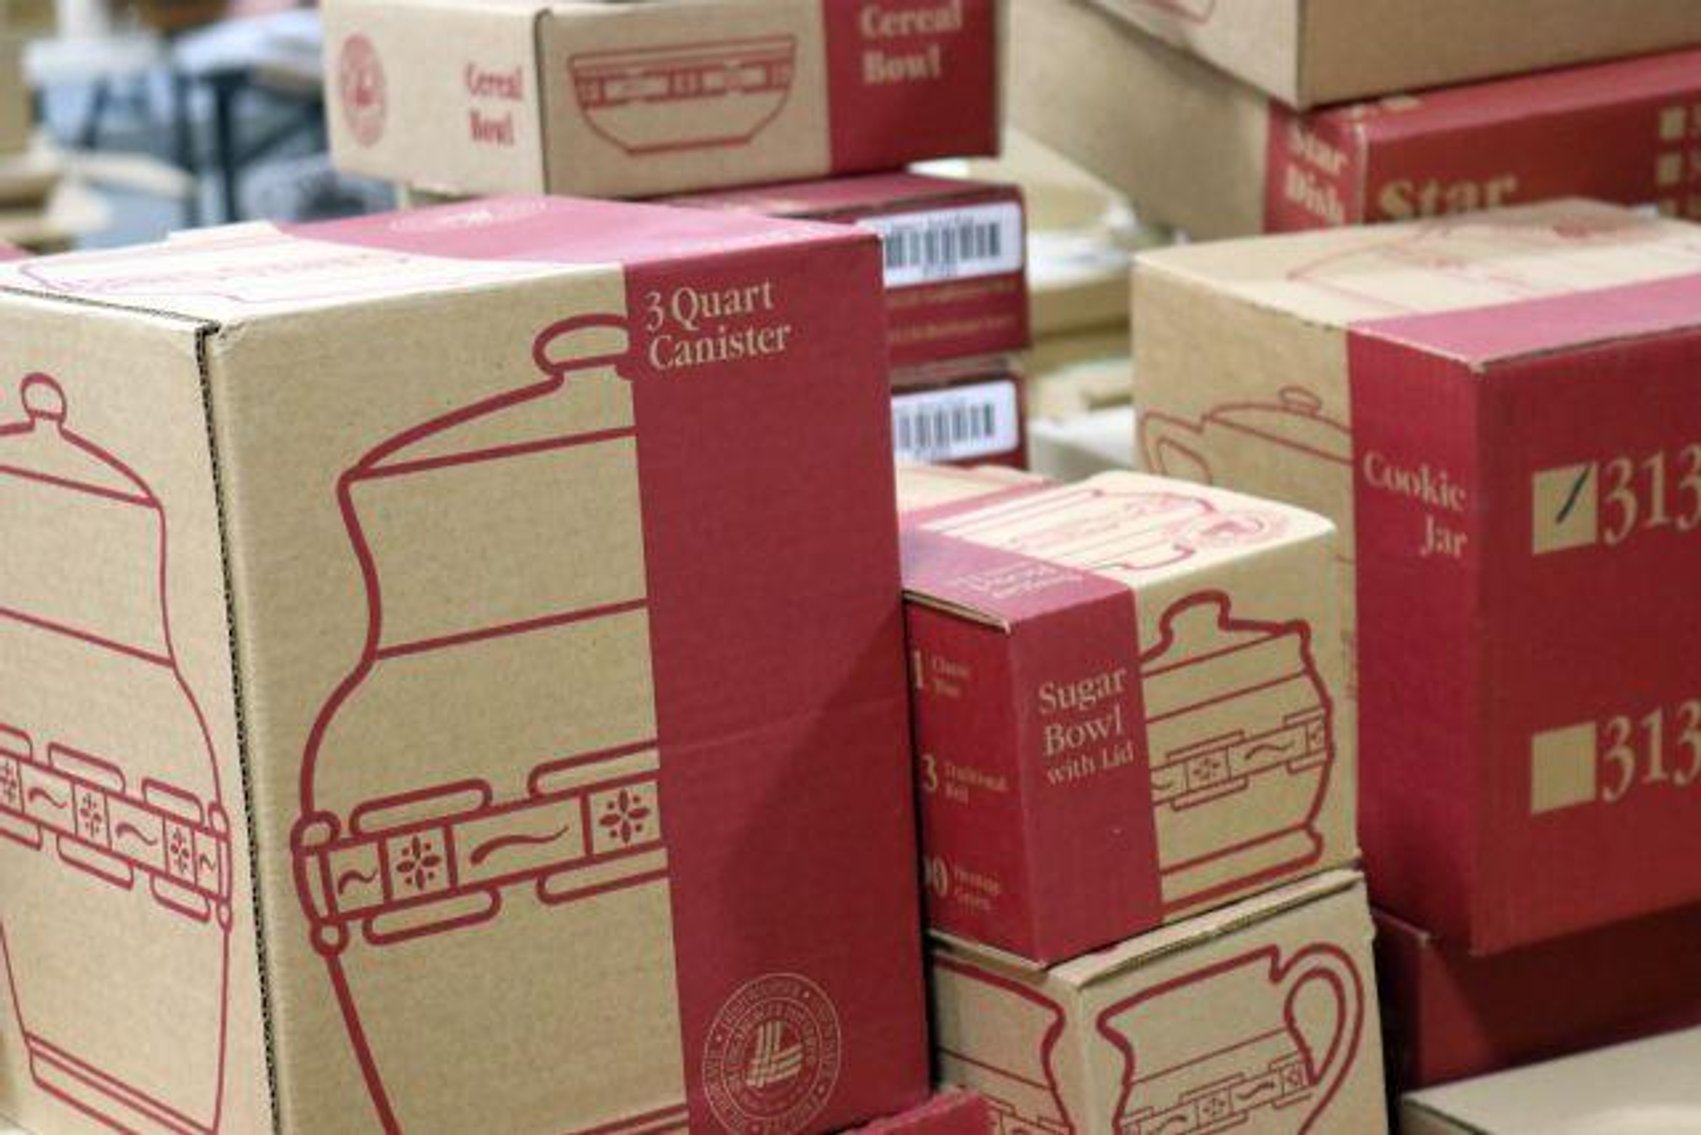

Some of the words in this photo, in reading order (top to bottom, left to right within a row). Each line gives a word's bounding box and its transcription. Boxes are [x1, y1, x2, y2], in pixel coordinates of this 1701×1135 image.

[860, 0, 963, 38] Cereal
[464, 61, 524, 101] Cereal
[863, 44, 941, 84] Bowl
[468, 109, 515, 147] Bowl
[1378, 174, 1518, 220] Star
[645, 291, 664, 331] 3
[671, 279, 774, 331] Quart
[649, 324, 792, 371] Canister
[1363, 451, 1467, 512] Cookie
[1602, 443, 1701, 547] 313
[1419, 515, 1468, 559] Jar
[1038, 668, 1128, 716] Sugar
[1043, 703, 1123, 757] Bowl
[1602, 699, 1701, 803] 313
[921, 754, 938, 793] 3
[1045, 753, 1098, 786] with
[1100, 741, 1135, 771] Lid
